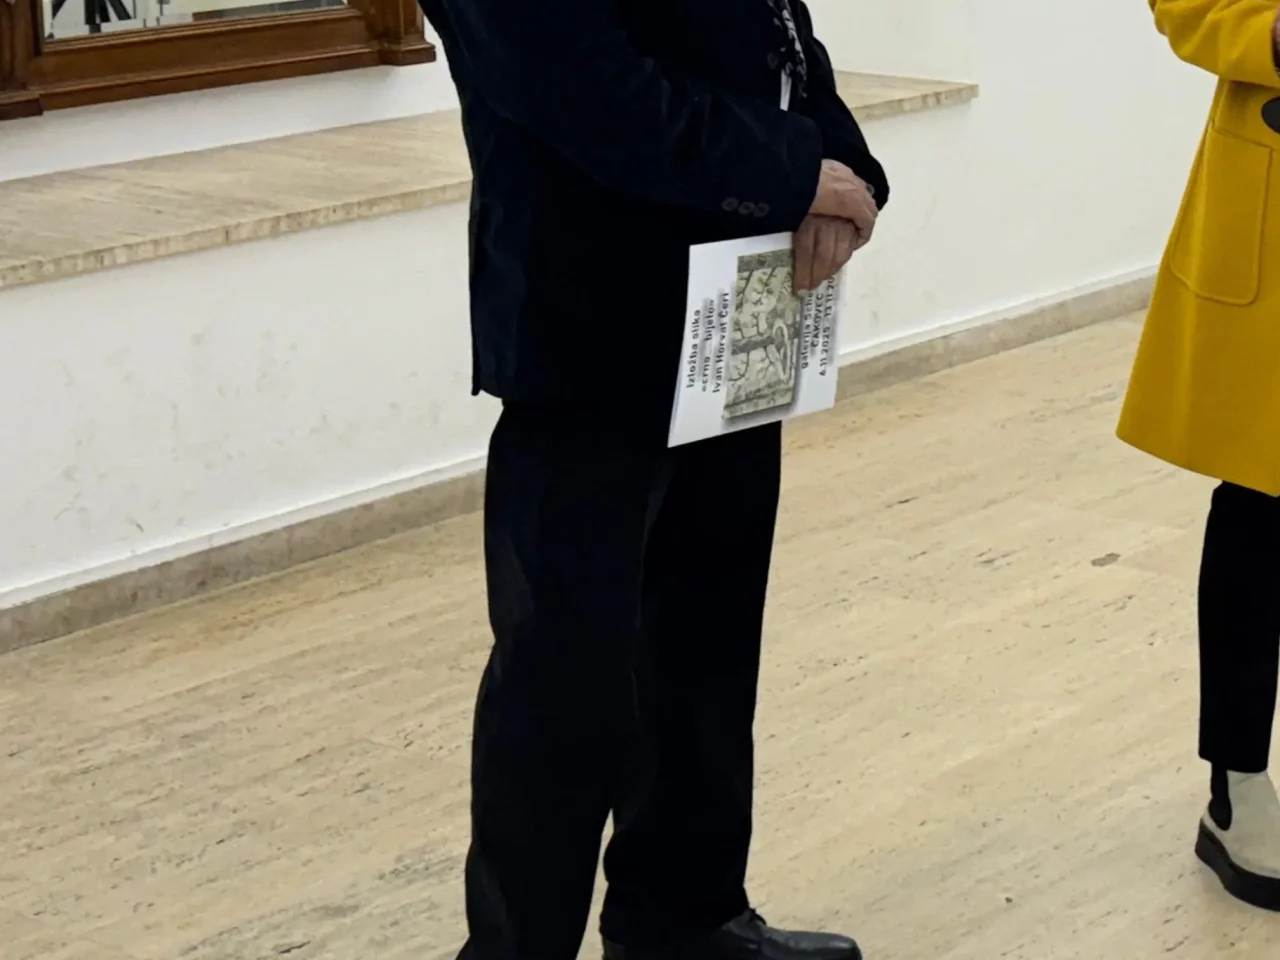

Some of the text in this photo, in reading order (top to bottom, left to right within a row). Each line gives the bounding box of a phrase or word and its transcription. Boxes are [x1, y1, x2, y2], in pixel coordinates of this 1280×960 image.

[715, 321, 728, 363] Horvat
[801, 292, 815, 369] galerija Sche
[712, 366, 724, 393] Ivan
